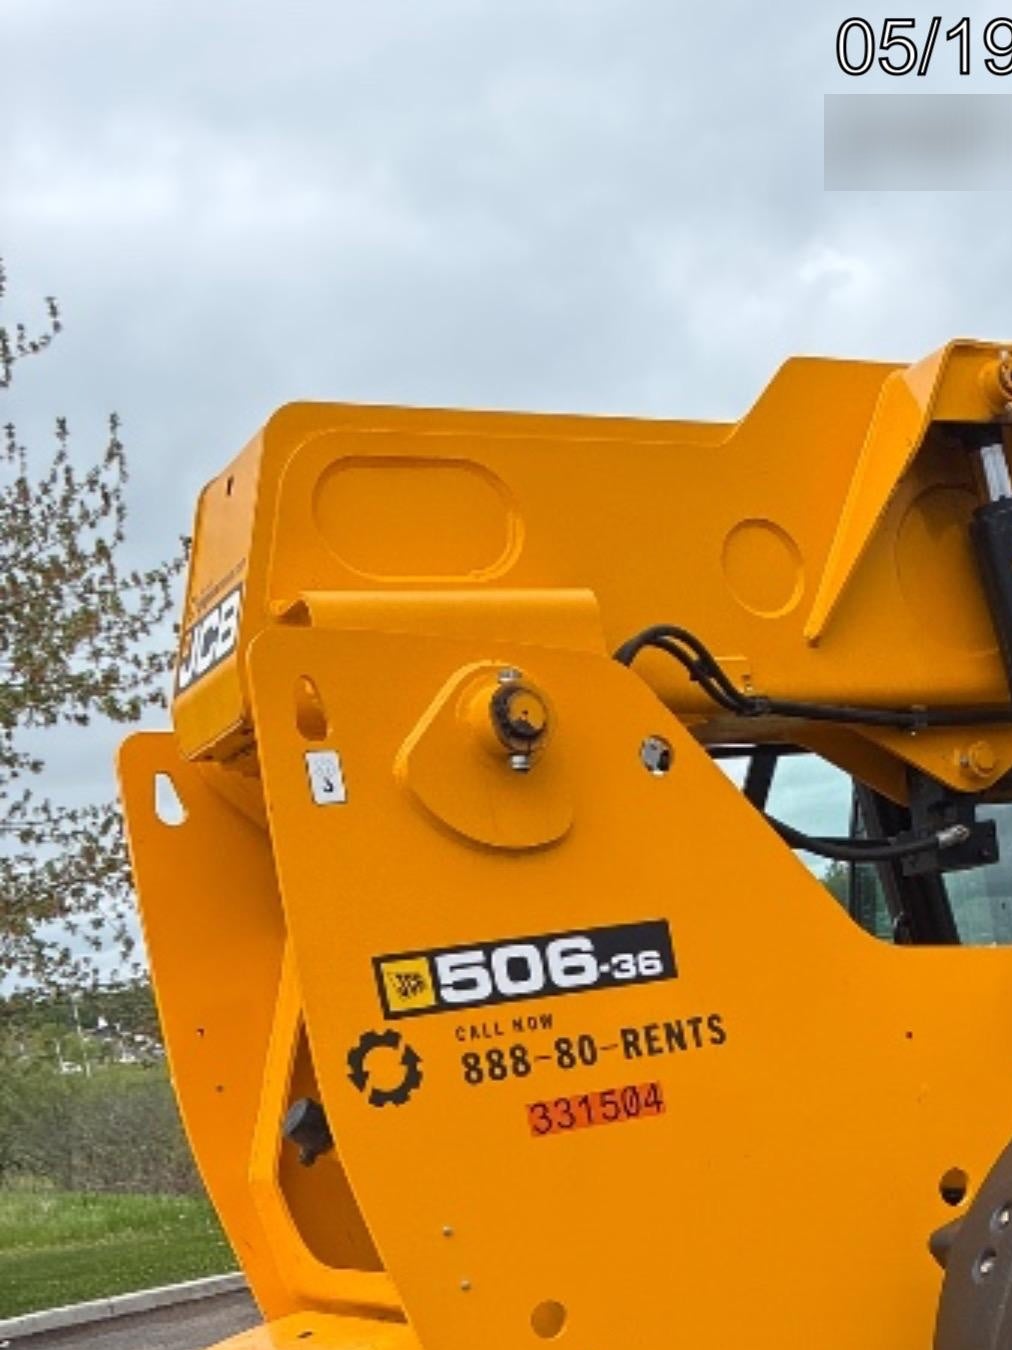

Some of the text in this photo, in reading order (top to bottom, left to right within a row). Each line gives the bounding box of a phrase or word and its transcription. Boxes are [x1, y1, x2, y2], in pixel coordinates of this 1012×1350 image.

[179, 590, 240, 689] JCB
[434, 935, 664, 1004] 506-36
[455, 1014, 553, 1041] CALL NOW
[461, 1013, 727, 1085] 888-80-RENTS
[529, 1082, 664, 1136] 331504
